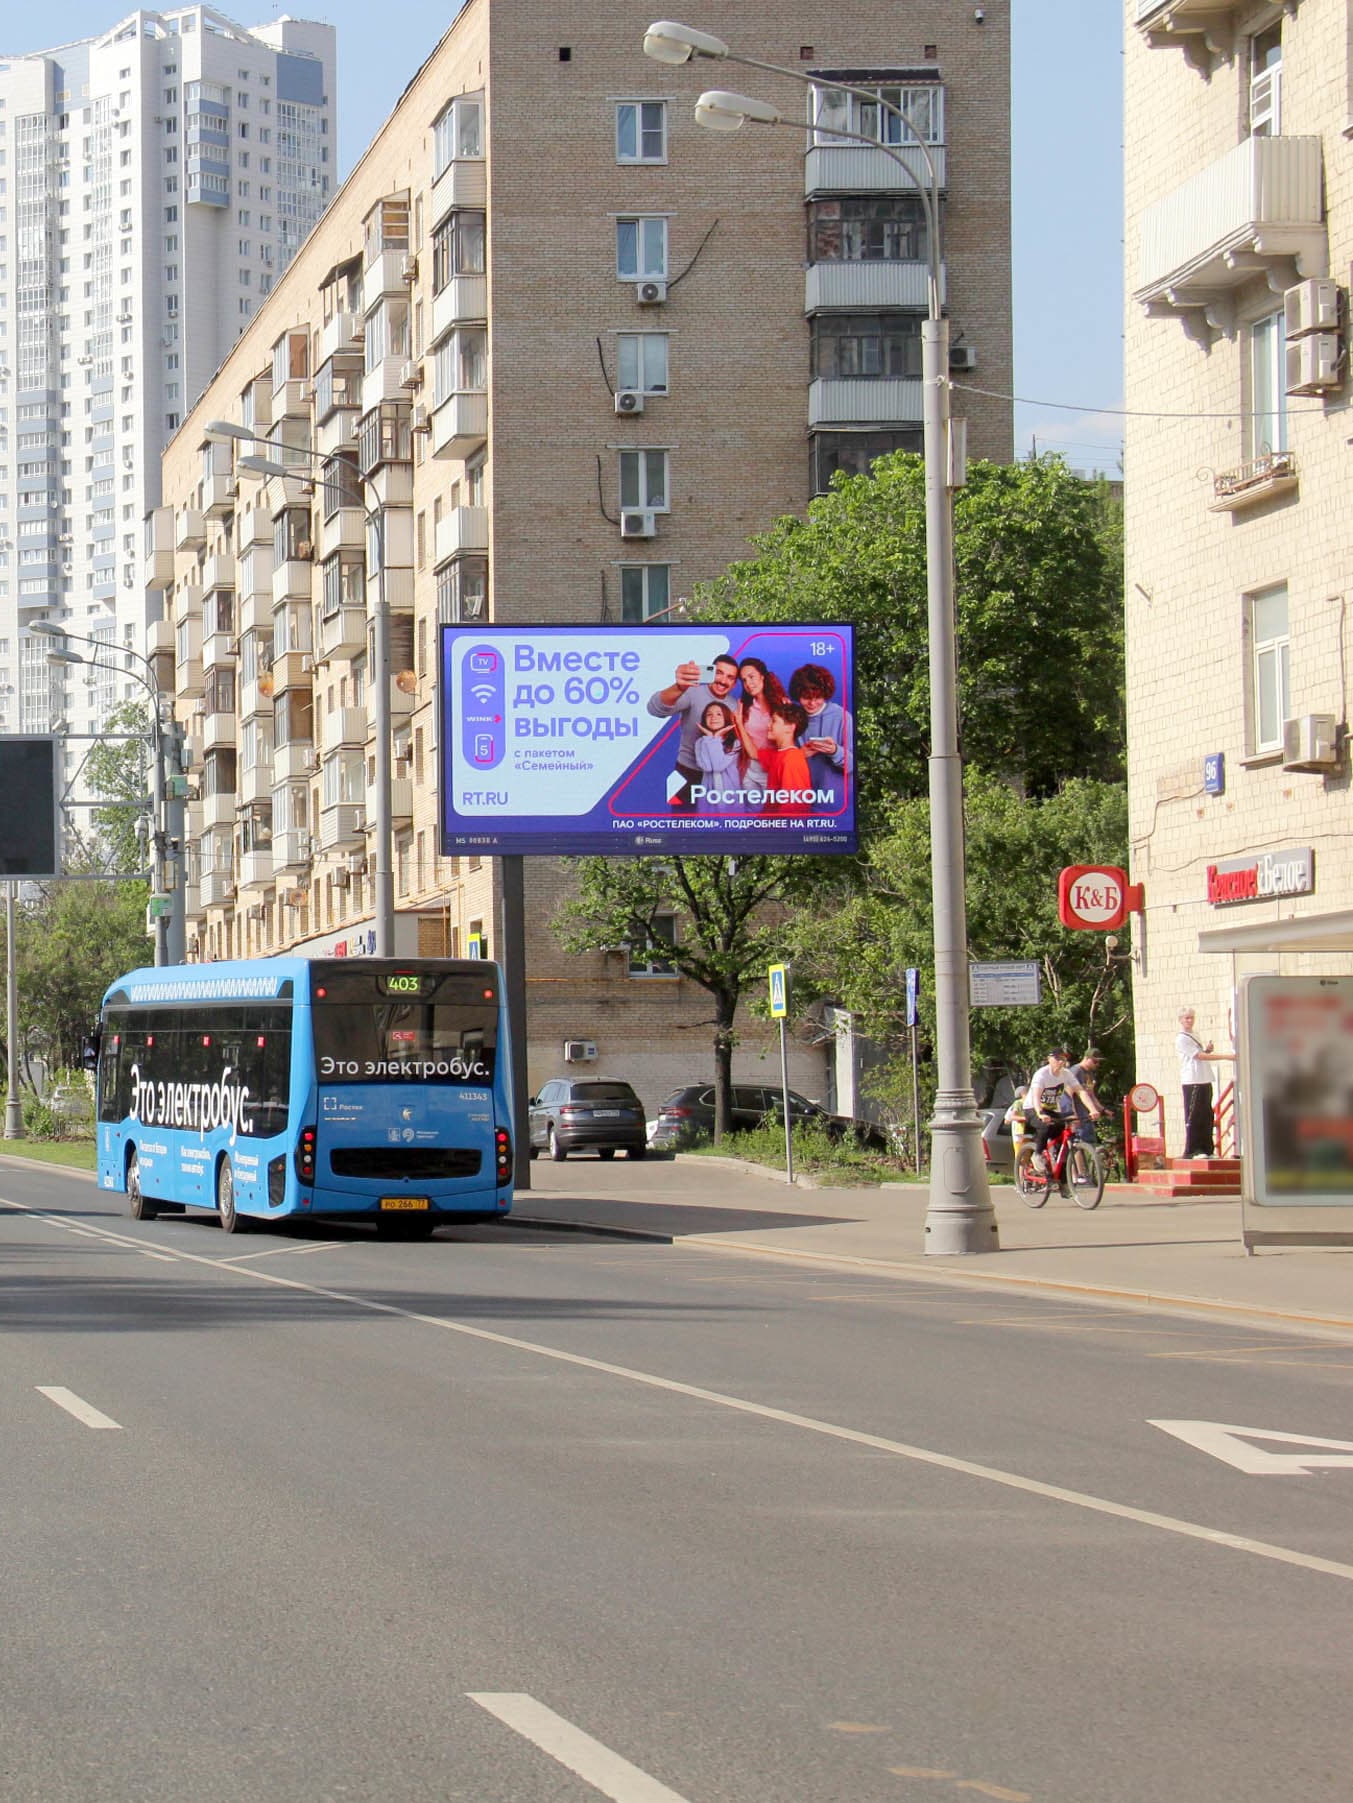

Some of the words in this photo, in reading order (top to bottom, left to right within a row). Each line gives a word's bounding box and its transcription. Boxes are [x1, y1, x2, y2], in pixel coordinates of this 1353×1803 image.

[514, 644, 640, 672] Вместе
[810, 642, 835, 656] 18+
[513, 685, 555, 708] до
[564, 677, 640, 704] 60%
[515, 717, 638, 740] выгоды
[480, 745, 488, 755] 5
[514, 750, 521, 758] с
[524, 750, 575, 758] пакетом
[514, 760, 594, 772] «Семейный»
[1206, 761, 1217, 780] 96
[462, 792, 509, 805] RT.RU
[690, 785, 835, 804] Ростелеком
[612, 820, 635, 829] ПАО
[725, 820, 787, 829] ПОДРОБНЕЕ
[790, 820, 804, 828] НА
[1075, 885, 1118, 910] К&Б
[389, 977, 419, 991] 403
[321, 1057, 359, 1075] Это
[365, 1057, 490, 1079] электробус.
[130, 1064, 155, 1123] Это
[158, 1066, 253, 1146] электробус.
